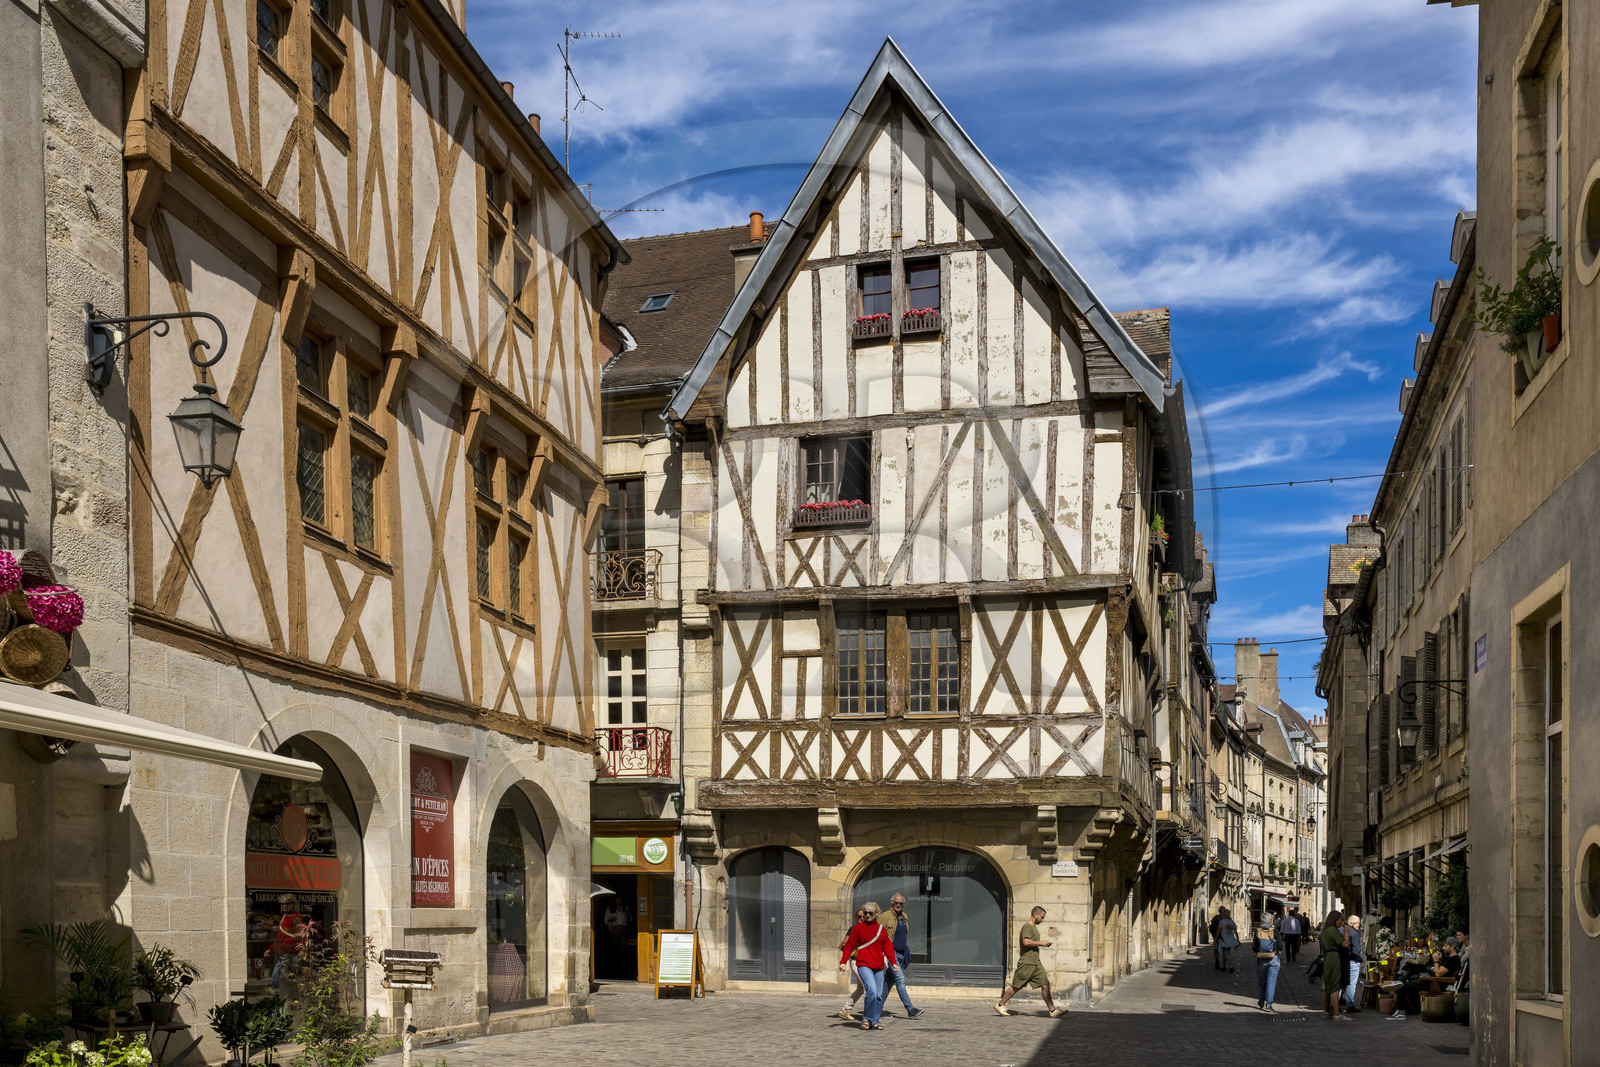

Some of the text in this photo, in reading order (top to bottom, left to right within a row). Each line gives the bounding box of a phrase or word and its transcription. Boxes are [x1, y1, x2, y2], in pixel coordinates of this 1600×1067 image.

[248, 862, 279, 880] MULOT
[293, 864, 338, 882] PETITJEAN
[422, 854, 449, 877] D'ÉPICES
[884, 862, 931, 871] Chocolatier
[939, 862, 976, 871] Pâtissier
[256, 894, 287, 902] FABRICA
